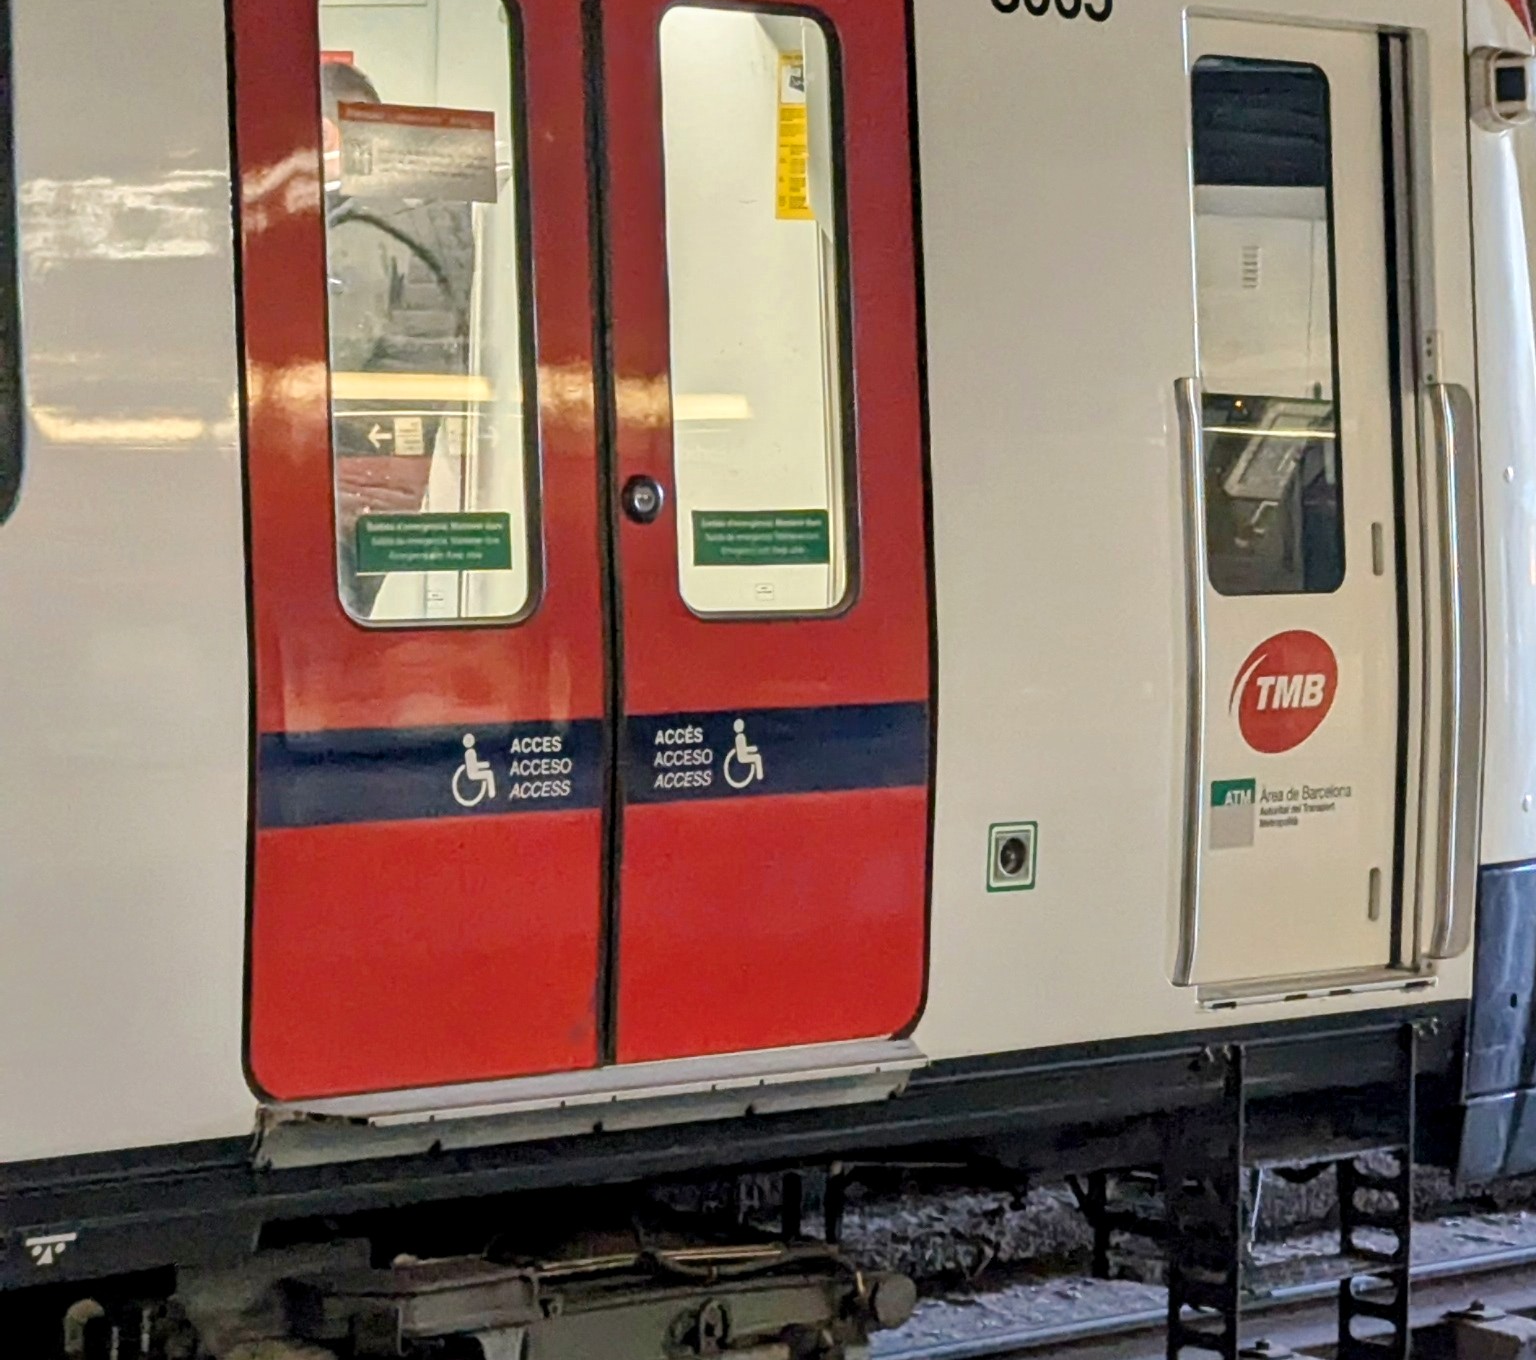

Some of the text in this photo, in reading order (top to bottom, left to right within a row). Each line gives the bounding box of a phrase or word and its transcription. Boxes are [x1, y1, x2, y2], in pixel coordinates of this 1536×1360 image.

[1256, 673, 1326, 711] TMB
[509, 757, 572, 777] ACCESO
[653, 748, 713, 768] ACCESO
[653, 770, 712, 789] ACCESS
[508, 780, 571, 800] ACCESS
[1224, 789, 1253, 806] ATM
[1286, 786, 1299, 802] de
[1302, 784, 1352, 801] Barcelona
